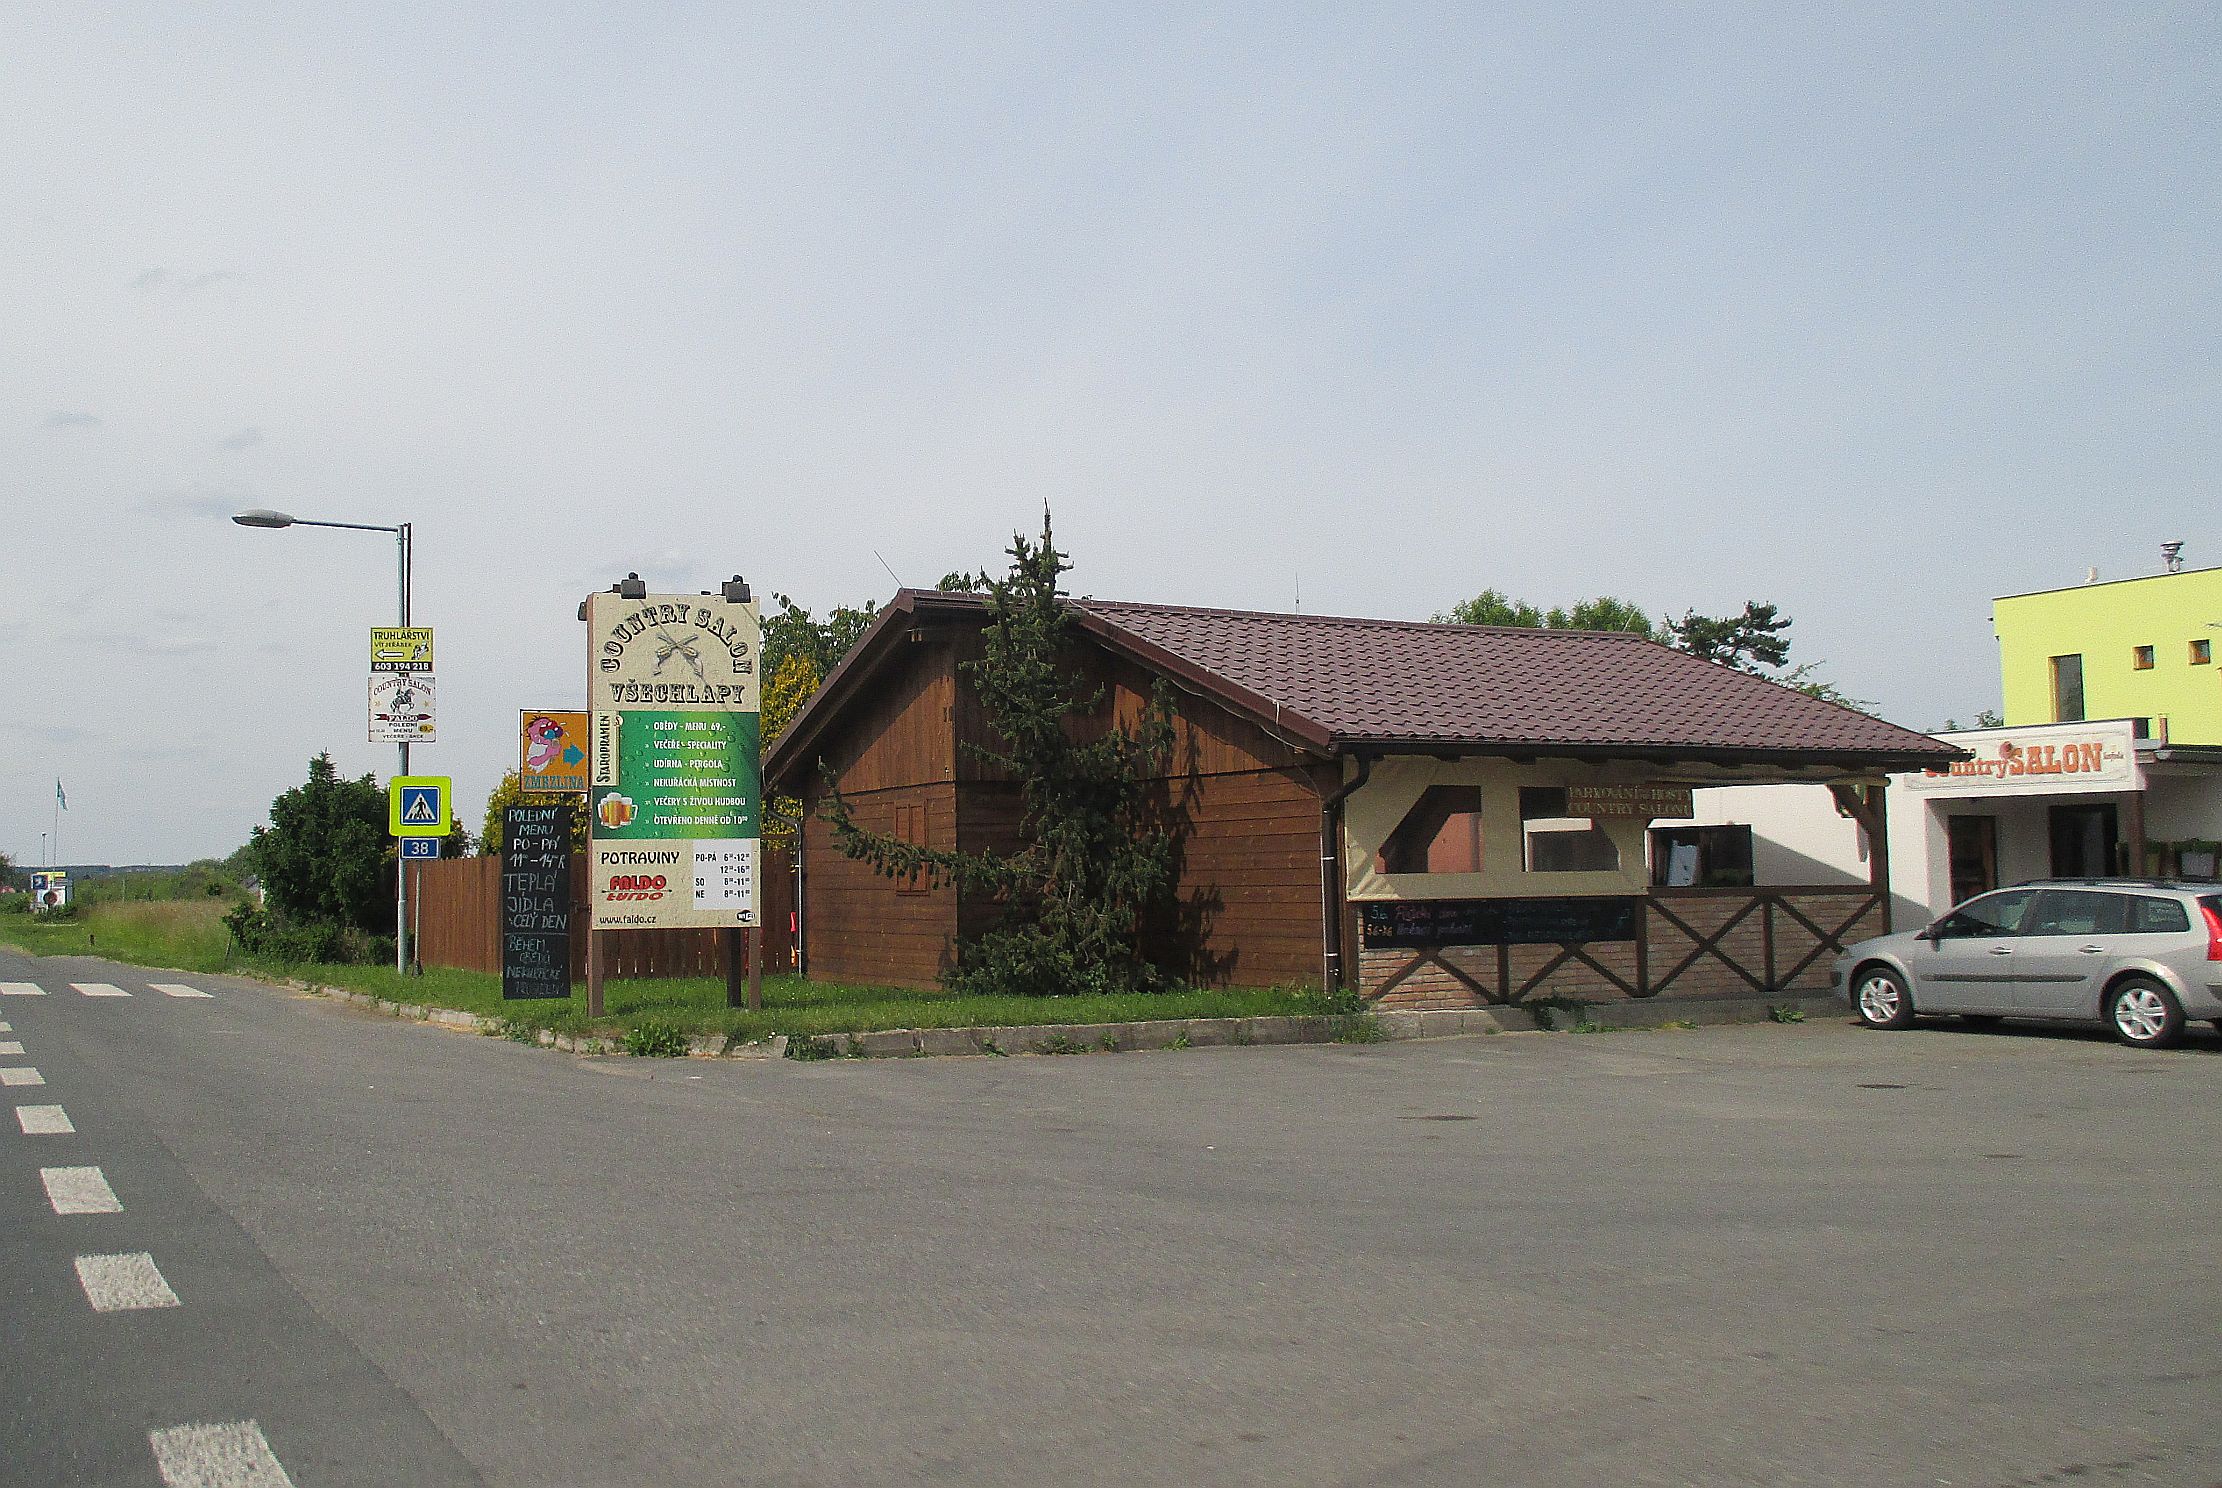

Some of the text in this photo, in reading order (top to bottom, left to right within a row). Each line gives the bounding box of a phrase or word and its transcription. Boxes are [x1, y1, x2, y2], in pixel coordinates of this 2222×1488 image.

[601, 604, 752, 674] COUNTRY SALON
[374, 679, 431, 695] COUNTRY SALON
[609, 679, 745, 704] VŠECHLAPY
[654, 721, 678, 730] OBĚDY
[685, 722, 707, 731] MENU
[654, 739, 680, 749] VEČEŘE
[687, 741, 726, 749] SPECIALITY
[654, 758, 682, 768] UDÍRNA
[690, 760, 723, 768] PERGOLA
[1925, 757, 2008, 778] untry
[2008, 742, 2103, 775] SALON
[699, 777, 736, 787] MÍSTNOST
[654, 796, 746, 806] VEČERY S ŽIVOU HUDBOU
[509, 807, 558, 822] POLEDNÍ
[1568, 802, 1632, 815] COUNTRY
[654, 815, 692, 825] OTEVŘENO
[720, 816, 731, 825] OD
[519, 824, 554, 836] MENU
[411, 842, 429, 855] 38
[513, 838, 530, 850] PO
[601, 852, 679, 864] POTRAVINY
[695, 851, 716, 862] PO-PÁ
[504, 869, 557, 892] TEPLÁ
[610, 875, 667, 890] FALDO
[695, 877, 705, 887] SO
[695, 889, 705, 898] NE
[507, 891, 554, 913] JÍDLA
[541, 914, 567, 929] DEN
[600, 915, 656, 925] www.faldo.cz
